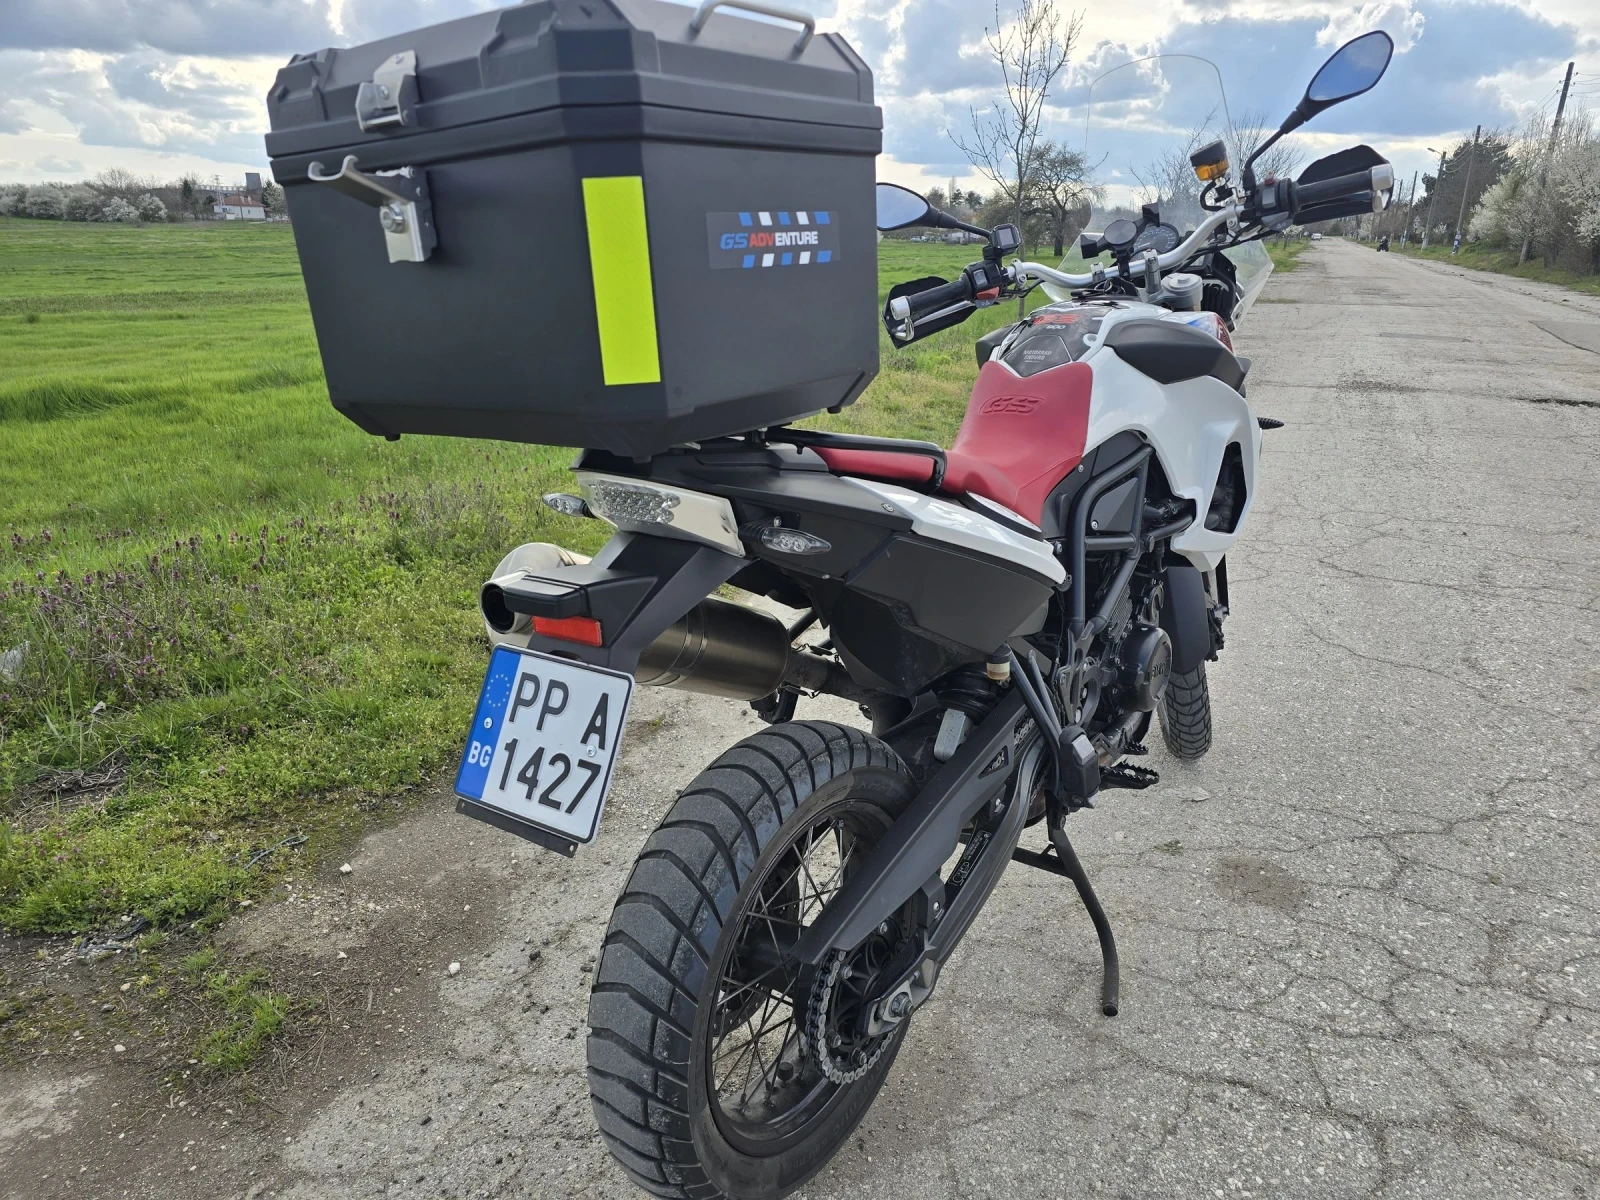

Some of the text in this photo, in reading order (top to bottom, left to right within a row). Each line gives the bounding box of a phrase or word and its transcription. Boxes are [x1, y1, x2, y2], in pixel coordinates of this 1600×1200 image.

[720, 231, 818, 250] GS ADVENTURE
[981, 397, 1040, 414] GS
[508, 671, 609, 750] PP A
[467, 740, 492, 768] BG
[499, 738, 602, 815] 1427
